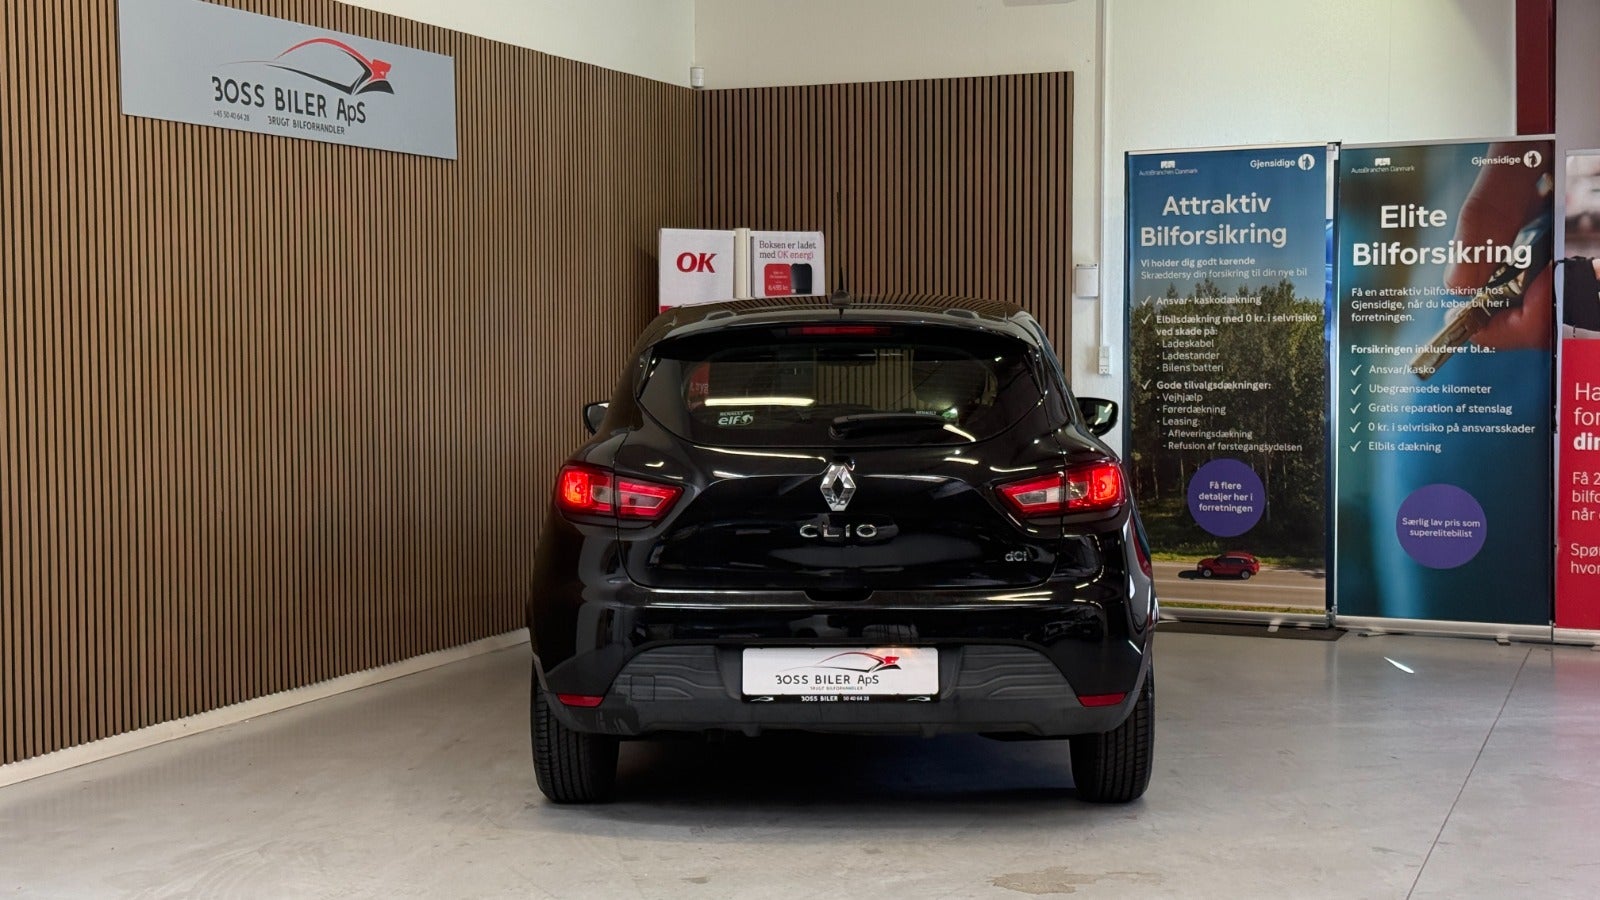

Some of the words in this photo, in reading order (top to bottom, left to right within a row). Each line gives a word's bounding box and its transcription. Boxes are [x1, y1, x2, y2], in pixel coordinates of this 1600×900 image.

[275, 87, 327, 118] BILER
[336, 98, 366, 127] ApS
[292, 118, 345, 136] BILFORHANDLER
[1250, 158, 1296, 170] Gjensidige
[1471, 155, 1521, 167] Gjensidige
[1162, 192, 1272, 217] Attraktiv
[1380, 203, 1447, 229] Elite
[1140, 223, 1287, 248] Bilforsikring
[759, 240, 786, 250] Boksen
[797, 240, 817, 250] ladet
[759, 250, 776, 259] med
[777, 250, 789, 259] OK
[1352, 238, 1532, 269] Bilforsikring
[676, 252, 718, 273] OK
[1141, 260, 1150, 268] Vi
[1151, 258, 1179, 268] holder
[1181, 258, 1195, 269] dig
[1197, 257, 1217, 268] godt
[1219, 256, 1256, 267] kørende
[1141, 270, 1191, 281] Skræddersy
[1193, 270, 1207, 279] din
[1209, 268, 1250, 279] forsikring
[1251, 269, 1261, 277] til
[1263, 268, 1277, 277] din
[1278, 270, 1294, 279] nye
[1296, 267, 1308, 276] bil
[1351, 287, 1363, 297] Få
[1366, 289, 1377, 297] en
[1379, 287, 1421, 296] attraktiv
[1423, 286, 1483, 297] bilforsikring
[1485, 287, 1504, 295] hos
[1194, 296, 1262, 306] kaskodækning
[1351, 301, 1405, 311] Gjensidige,
[1407, 299, 1423, 309] når
[1426, 299, 1438, 309] du
[1487, 298, 1503, 308] her
[1156, 315, 1221, 326] Elbilsdækning
[1222, 315, 1243, 323] med
[1245, 314, 1251, 323] 0
[1254, 314, 1266, 323] kr.
[1272, 313, 1317, 322] selvrisiko
[1351, 313, 1415, 324] forretningen.
[1156, 328, 1173, 336] ved
[1175, 327, 1202, 336] skade
[1204, 327, 1218, 338] på:
[1162, 340, 1214, 349] Ladeskabel
[1162, 352, 1220, 361] Ladestander
[1351, 345, 1413, 357] Forsikringen
[1415, 345, 1469, 354] inkluderer
[1162, 364, 1191, 373] Bilens
[1193, 364, 1224, 373] batteri
[1369, 365, 1436, 375] Ansvar/kasko
[1156, 381, 1182, 390] Gode
[1368, 384, 1440, 395] Ubegrænsede
[1442, 384, 1492, 394] kilometer
[1162, 393, 1204, 403] Vejhjælp
[1162, 405, 1227, 416] Førerdækning
[1368, 403, 1399, 413] Gratis
[1400, 404, 1453, 415] reparation
[1455, 404, 1466, 413] af
[1468, 405, 1513, 416] stenslag
[718, 416, 741, 425] elf
[1368, 423, 1375, 432] 0
[1377, 422, 1390, 432] kr.
[1397, 423, 1444, 432] selvrisiko
[1446, 423, 1460, 434] på
[1461, 424, 1536, 434] ansvarsskader
[1168, 429, 1253, 440] Afleveringsdækning
[1168, 442, 1206, 450] Refusion
[1207, 442, 1216, 450] af
[1368, 441, 1396, 451] Elbils
[1398, 442, 1442, 453] dækning
[1572, 472, 1589, 485] Få
[1209, 481, 1220, 490] Få
[1221, 481, 1242, 490] flere
[1198, 492, 1232, 502] detaljer
[1233, 493, 1249, 501] her
[1199, 503, 1253, 514] forretningen
[1571, 508, 1595, 521] når
[1402, 517, 1430, 528] Særlig
[1430, 518, 1443, 526] lav
[1444, 519, 1461, 528] pris
[1462, 520, 1481, 528] som
[800, 524, 877, 538] CLIO
[1409, 529, 1473, 538] superelitebilist
[1570, 543, 1600, 558] Spø
[815, 674, 851, 685] BILER
[857, 674, 880, 687] ApS
